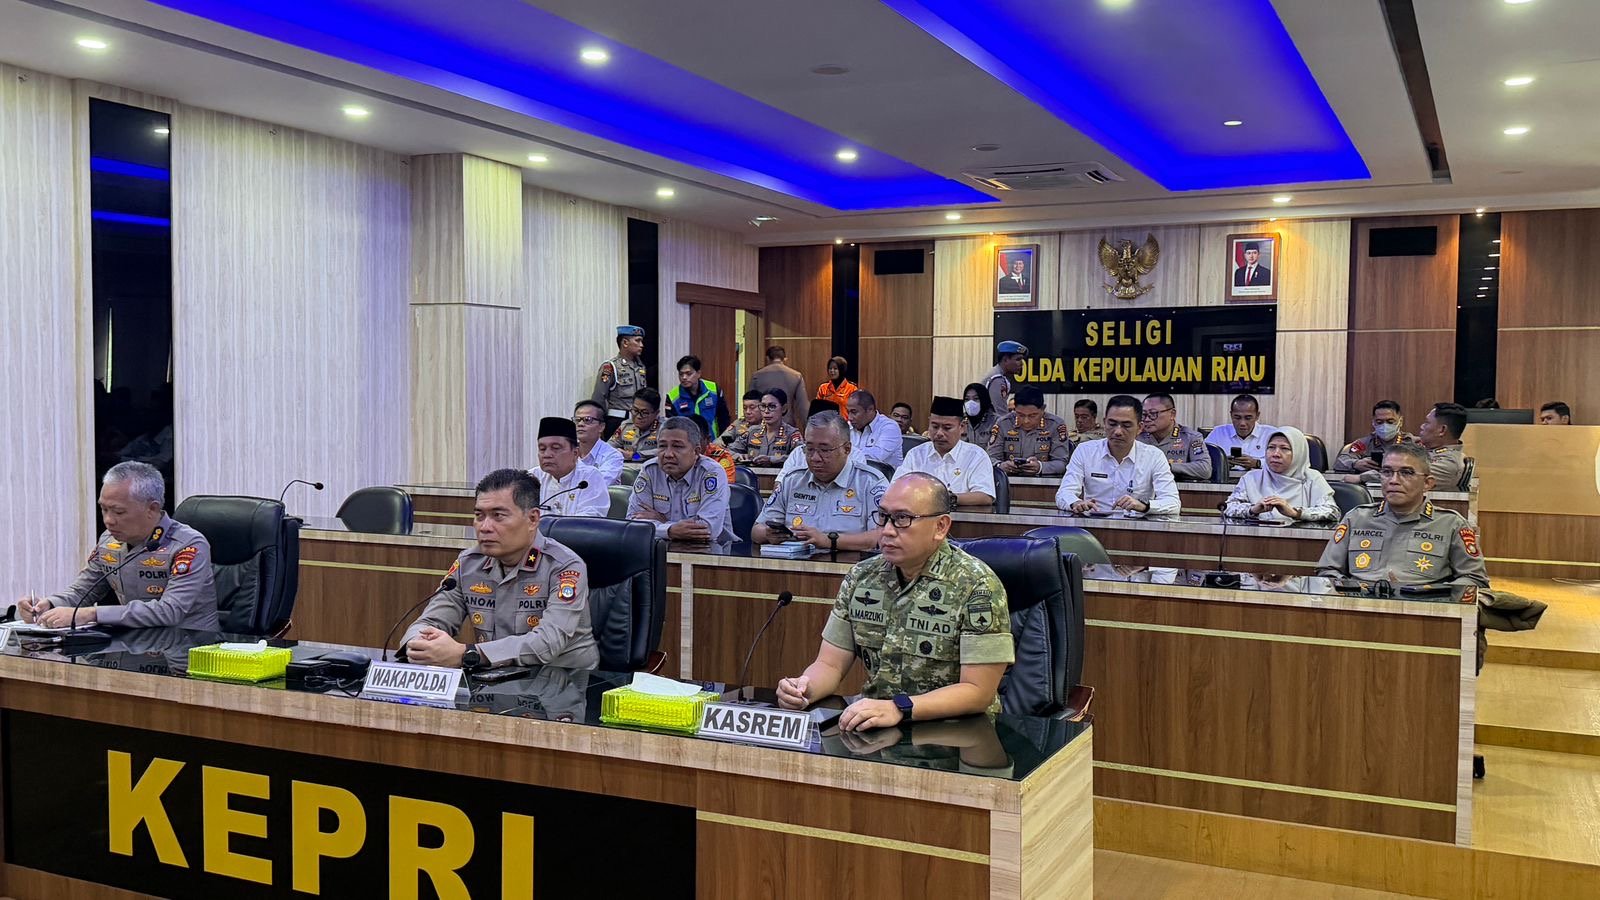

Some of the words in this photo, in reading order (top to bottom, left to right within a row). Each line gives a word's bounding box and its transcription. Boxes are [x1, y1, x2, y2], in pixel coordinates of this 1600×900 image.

[1086, 319, 1173, 347] SELIGI
[1014, 357, 1066, 383] OLDA
[1073, 355, 1202, 382] KEPULAUAN
[1211, 355, 1266, 381] RIAU
[793, 491, 817, 502] GENTUR
[1353, 529, 1384, 538] MARCEL
[1413, 530, 1444, 542] POLRI
[139, 570, 168, 580] POLRI
[518, 600, 547, 610] POLRI
[909, 617, 929, 631] TNI
[932, 621, 951, 634] AD
[372, 667, 447, 693] WAKAPOLDA
[704, 706, 802, 741] KASREM
[107, 749, 535, 900] KEPRI
